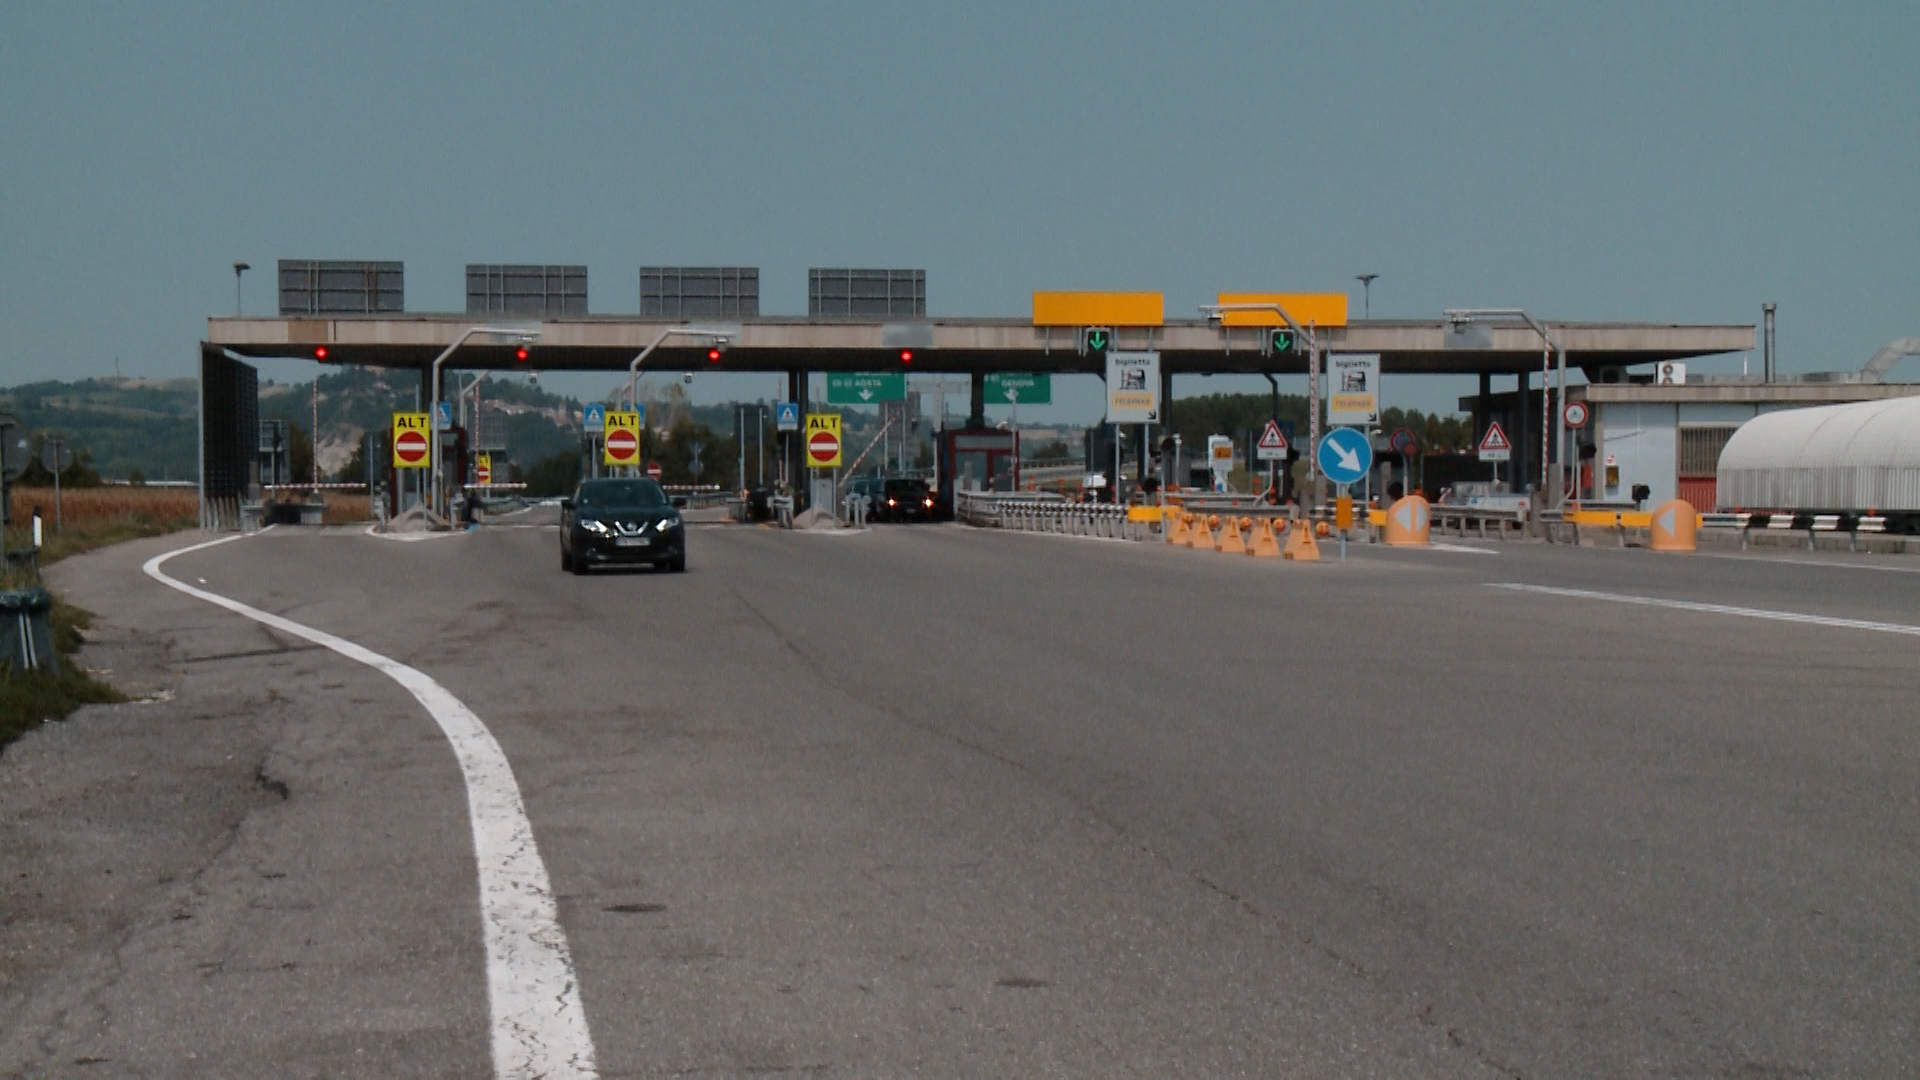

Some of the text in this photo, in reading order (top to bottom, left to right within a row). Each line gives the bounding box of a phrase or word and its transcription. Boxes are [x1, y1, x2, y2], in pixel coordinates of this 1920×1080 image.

[397, 417, 427, 428] ALT
[608, 415, 637, 426] ALT
[810, 417, 838, 429] ALT
